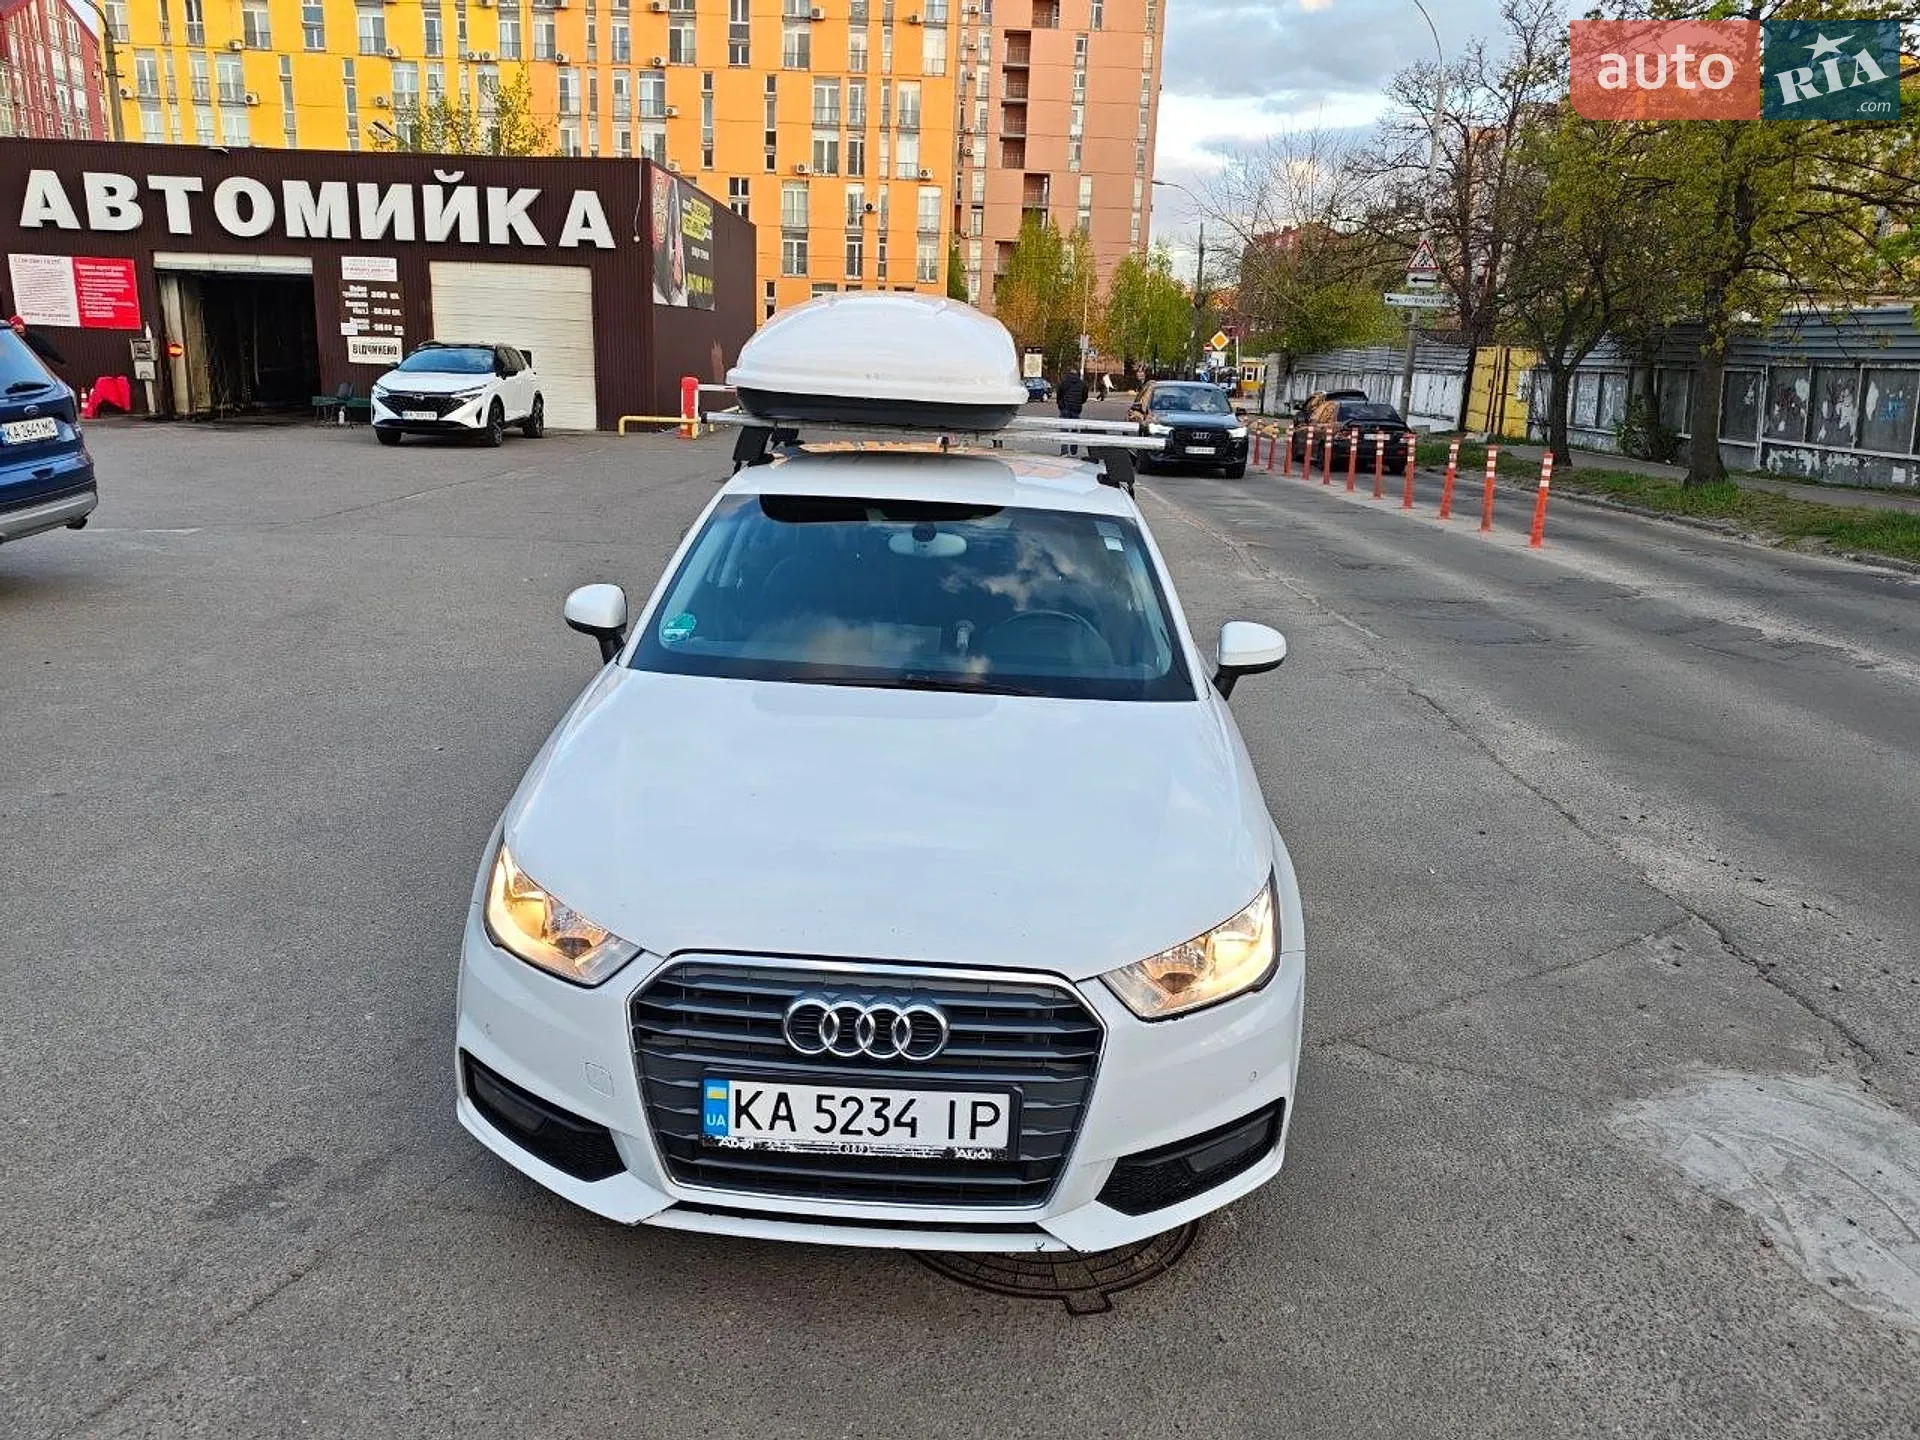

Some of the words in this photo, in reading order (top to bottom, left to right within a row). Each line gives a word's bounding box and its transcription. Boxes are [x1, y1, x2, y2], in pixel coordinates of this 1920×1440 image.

[19, 168, 617, 249] АВТОМИЙКА
[706, 1112, 726, 1127] UA
[734, 1089, 797, 1133] KA
[813, 1093, 917, 1139] 5234
[947, 1099, 1001, 1141] IP
